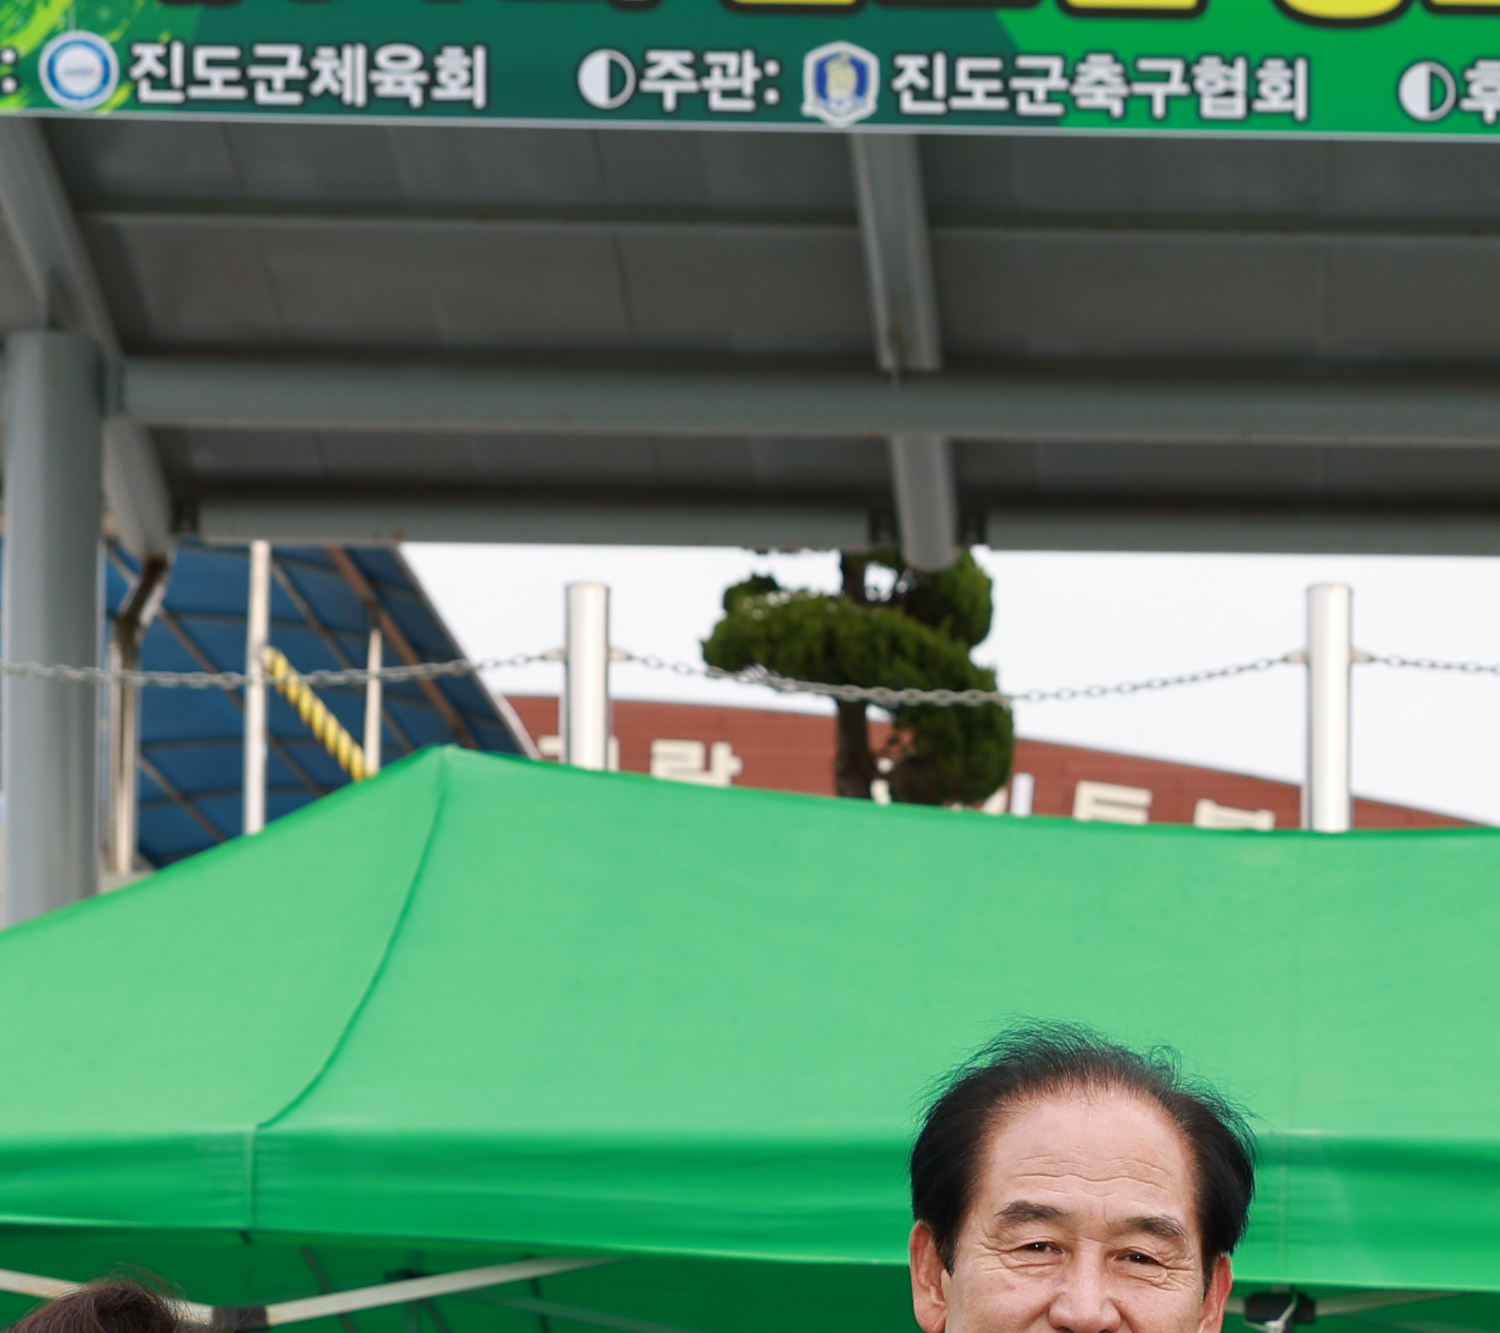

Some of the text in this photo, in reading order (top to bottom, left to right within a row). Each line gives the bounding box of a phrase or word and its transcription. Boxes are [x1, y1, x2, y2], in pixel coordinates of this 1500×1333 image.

[129, 44, 488, 108] 진도군체육회
[640, 49, 780, 112] 주관:
[893, 53, 1308, 121] 진도군축구협회
